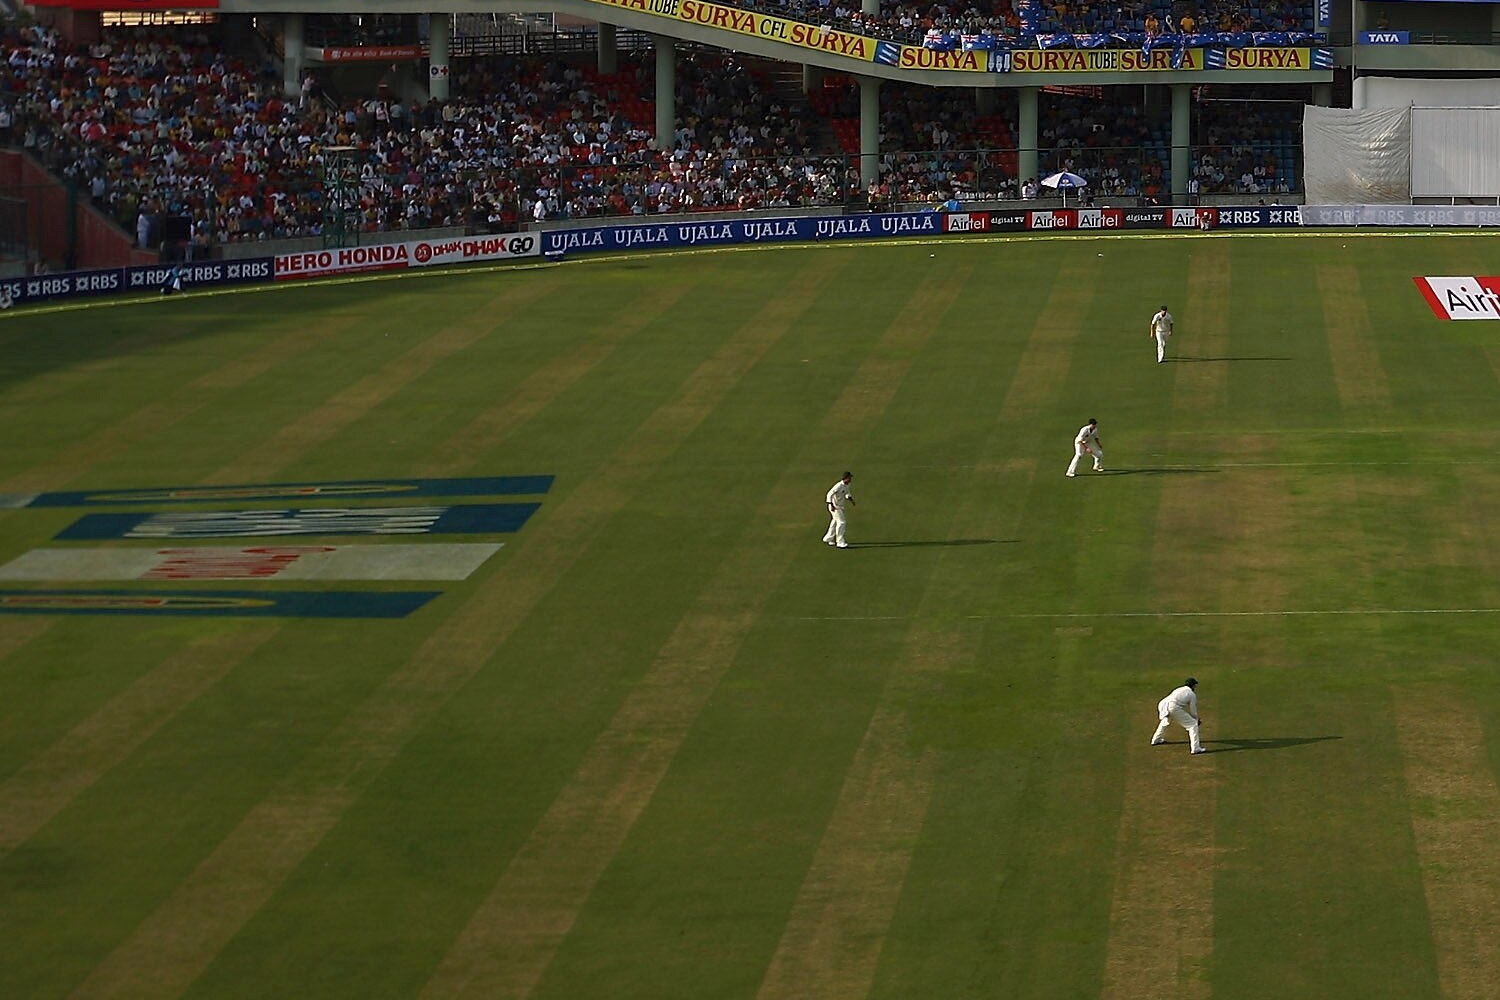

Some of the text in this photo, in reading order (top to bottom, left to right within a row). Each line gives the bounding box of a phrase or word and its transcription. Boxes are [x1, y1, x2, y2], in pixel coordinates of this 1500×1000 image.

[680, 0, 758, 34] SURYA
[760, 18, 788, 40] CFL
[790, 23, 866, 58] SURYA
[1368, 34, 1400, 44] TATA
[902, 48, 1300, 70] SURYA SURYA TUBE SURYA
[950, 216, 1012, 231] Airtel digital
[1032, 212, 1068, 228] Airtel
[1078, 212, 1150, 228] Airtel digital
[1234, 210, 1260, 224] RBS
[552, 216, 934, 250] UJALA UJALA UJALA UJALA UJALA UJALA
[434, 236, 534, 257] DHAK DHAK GO
[275, 244, 408, 272] HERO HONDA
[194, 262, 269, 282] RBS RBS
[42, 274, 118, 295] RBS RBS
